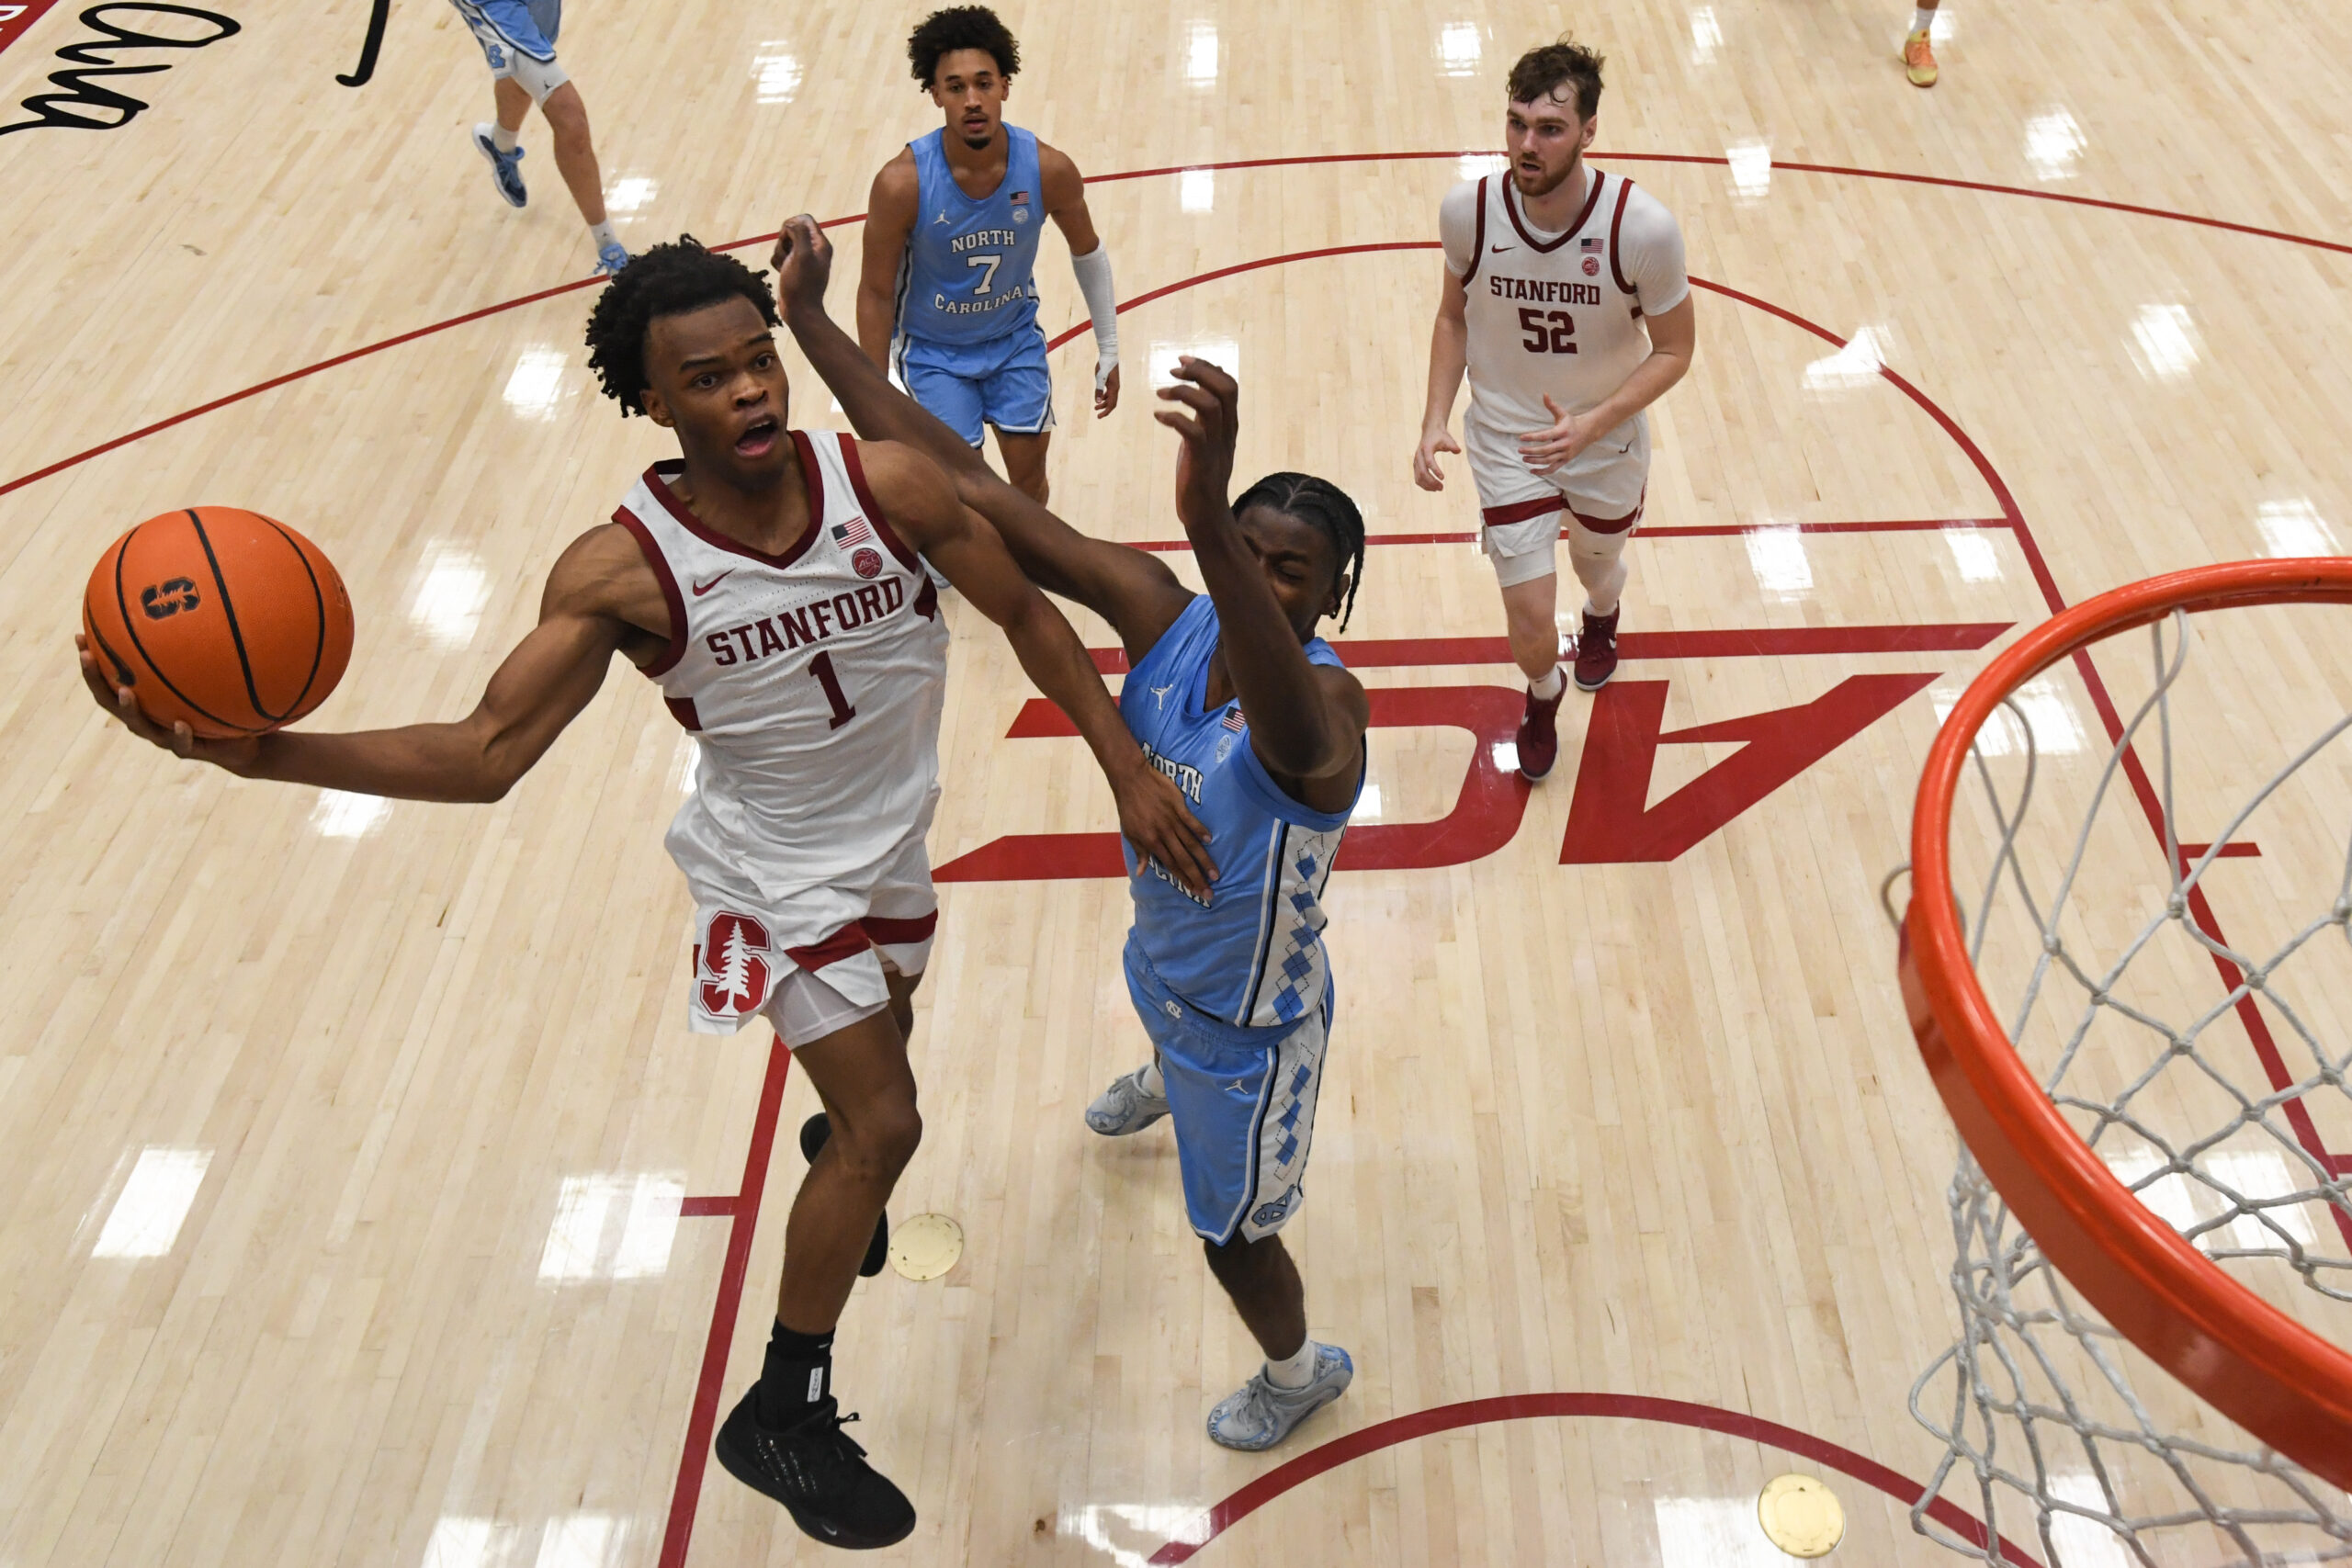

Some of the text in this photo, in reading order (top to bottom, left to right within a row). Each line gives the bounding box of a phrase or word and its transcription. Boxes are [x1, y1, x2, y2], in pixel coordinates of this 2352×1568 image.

[951, 230, 1015, 254] NORTH
[967, 254, 1002, 296] 7
[1490, 276, 1600, 306] STANFORD
[934, 286, 1024, 314] CAROLINA
[1518, 308, 1578, 355] 52
[706, 576, 903, 667] STANFORD
[808, 649, 856, 731] 1
